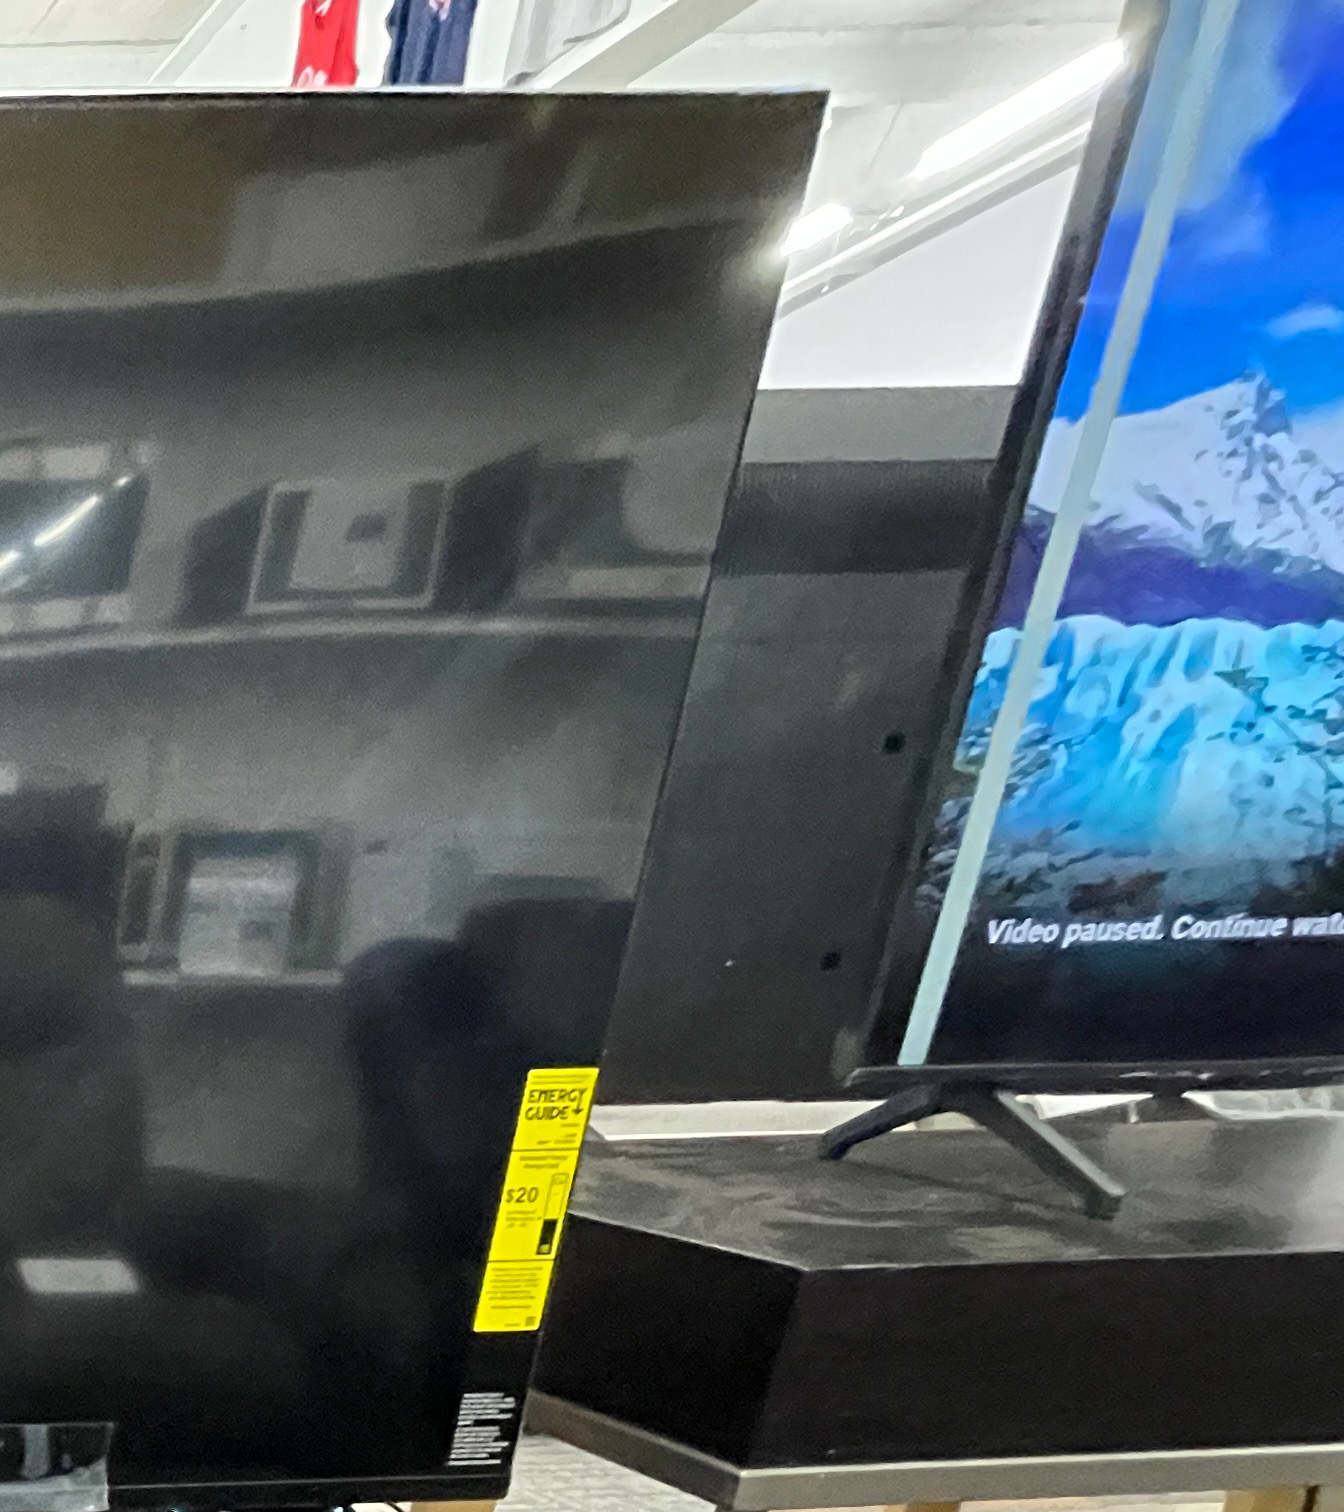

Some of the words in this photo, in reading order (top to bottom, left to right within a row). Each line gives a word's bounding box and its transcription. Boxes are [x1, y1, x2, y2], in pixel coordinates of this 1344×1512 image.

[987, 918, 1059, 944] Video
[1062, 914, 1164, 949] paused.
[1171, 912, 1288, 940] Continue
[527, 1087, 587, 1103] ENERGY
[524, 1106, 569, 1120] GUIDE
[505, 1186, 539, 1203] $20
